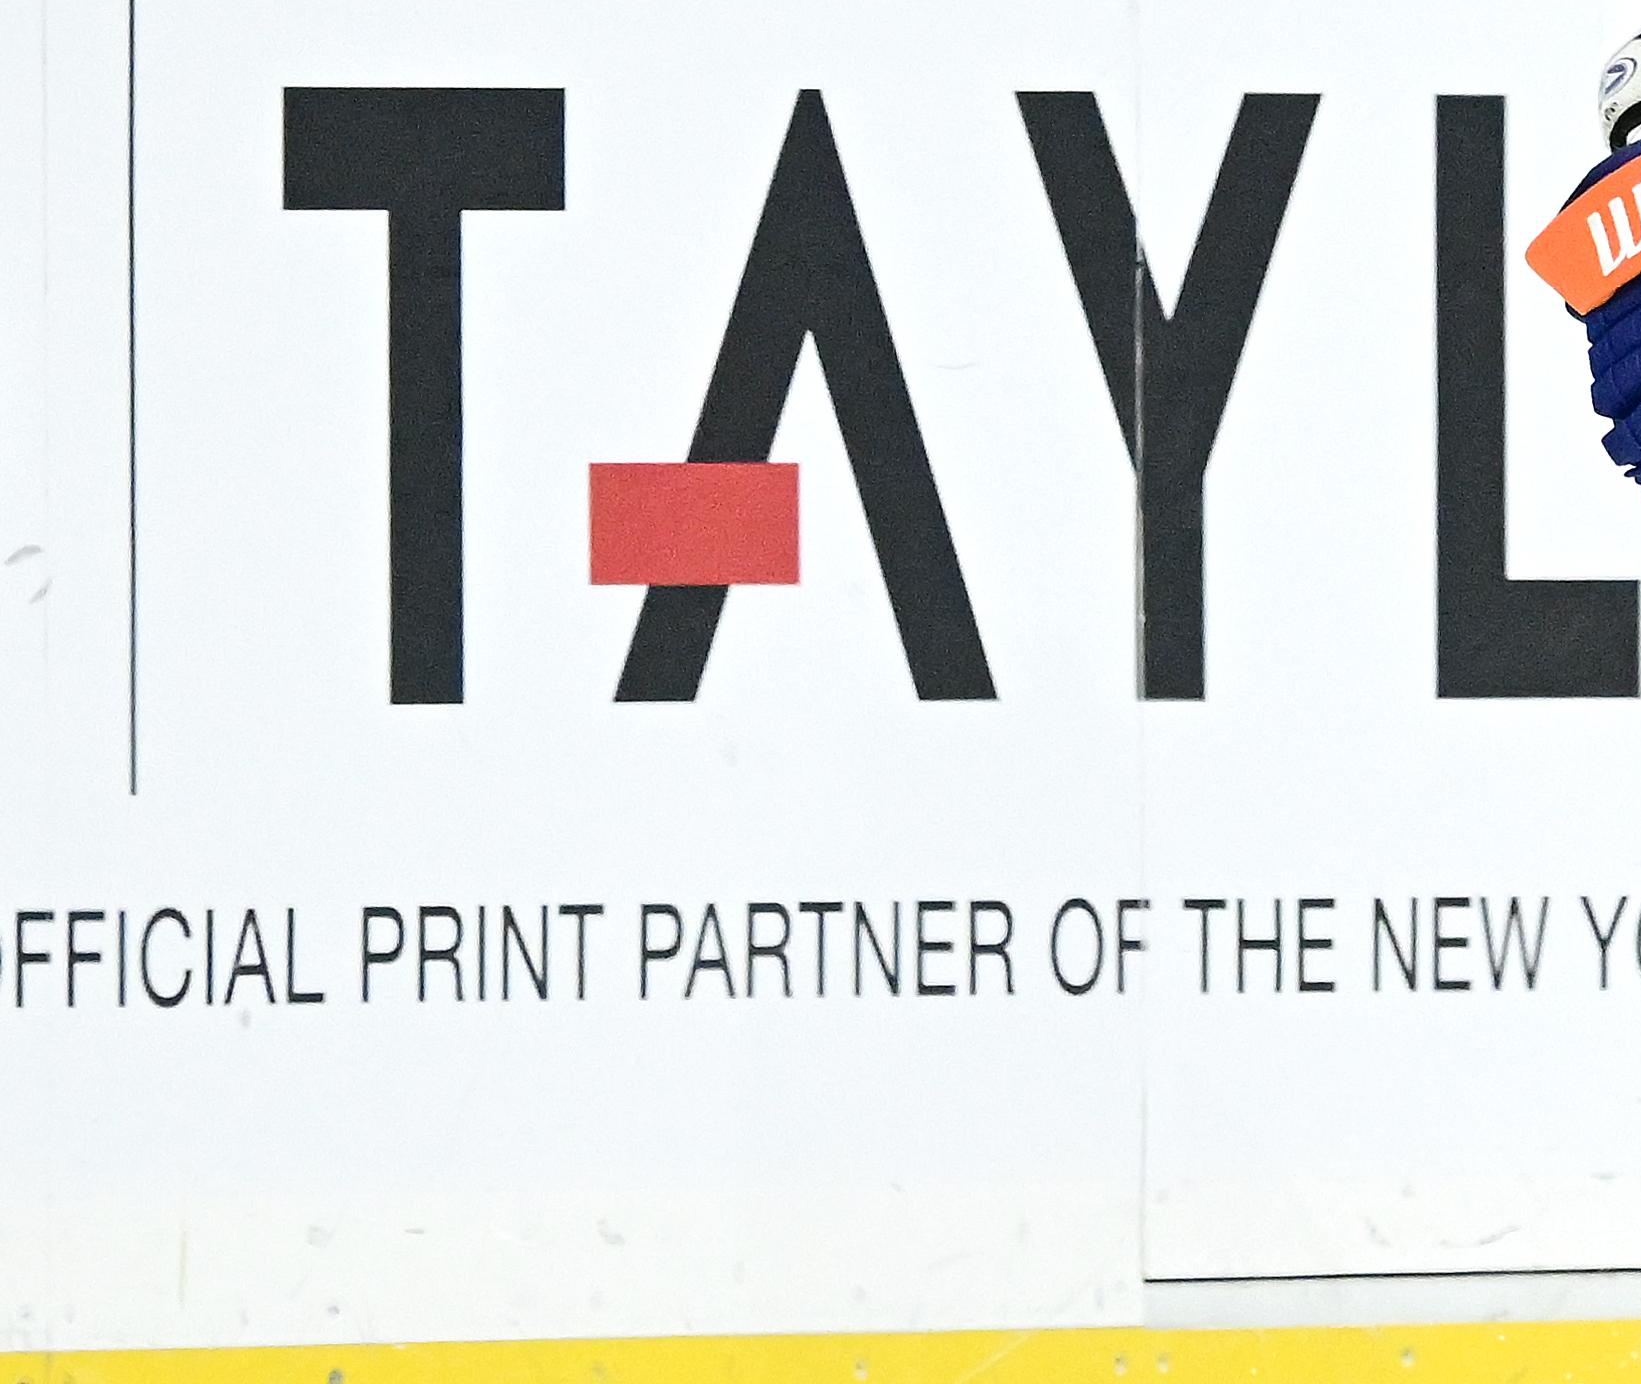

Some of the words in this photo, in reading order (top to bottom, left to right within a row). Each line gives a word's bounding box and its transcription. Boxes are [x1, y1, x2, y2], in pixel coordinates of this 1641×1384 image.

[0, 906, 325, 1008] FFICIAL
[360, 904, 604, 1002] PRINT
[640, 900, 1016, 1000] PARTNER
[1050, 898, 1150, 996] OF
[1183, 898, 1336, 994] THE
[1373, 896, 1549, 992] NEW
